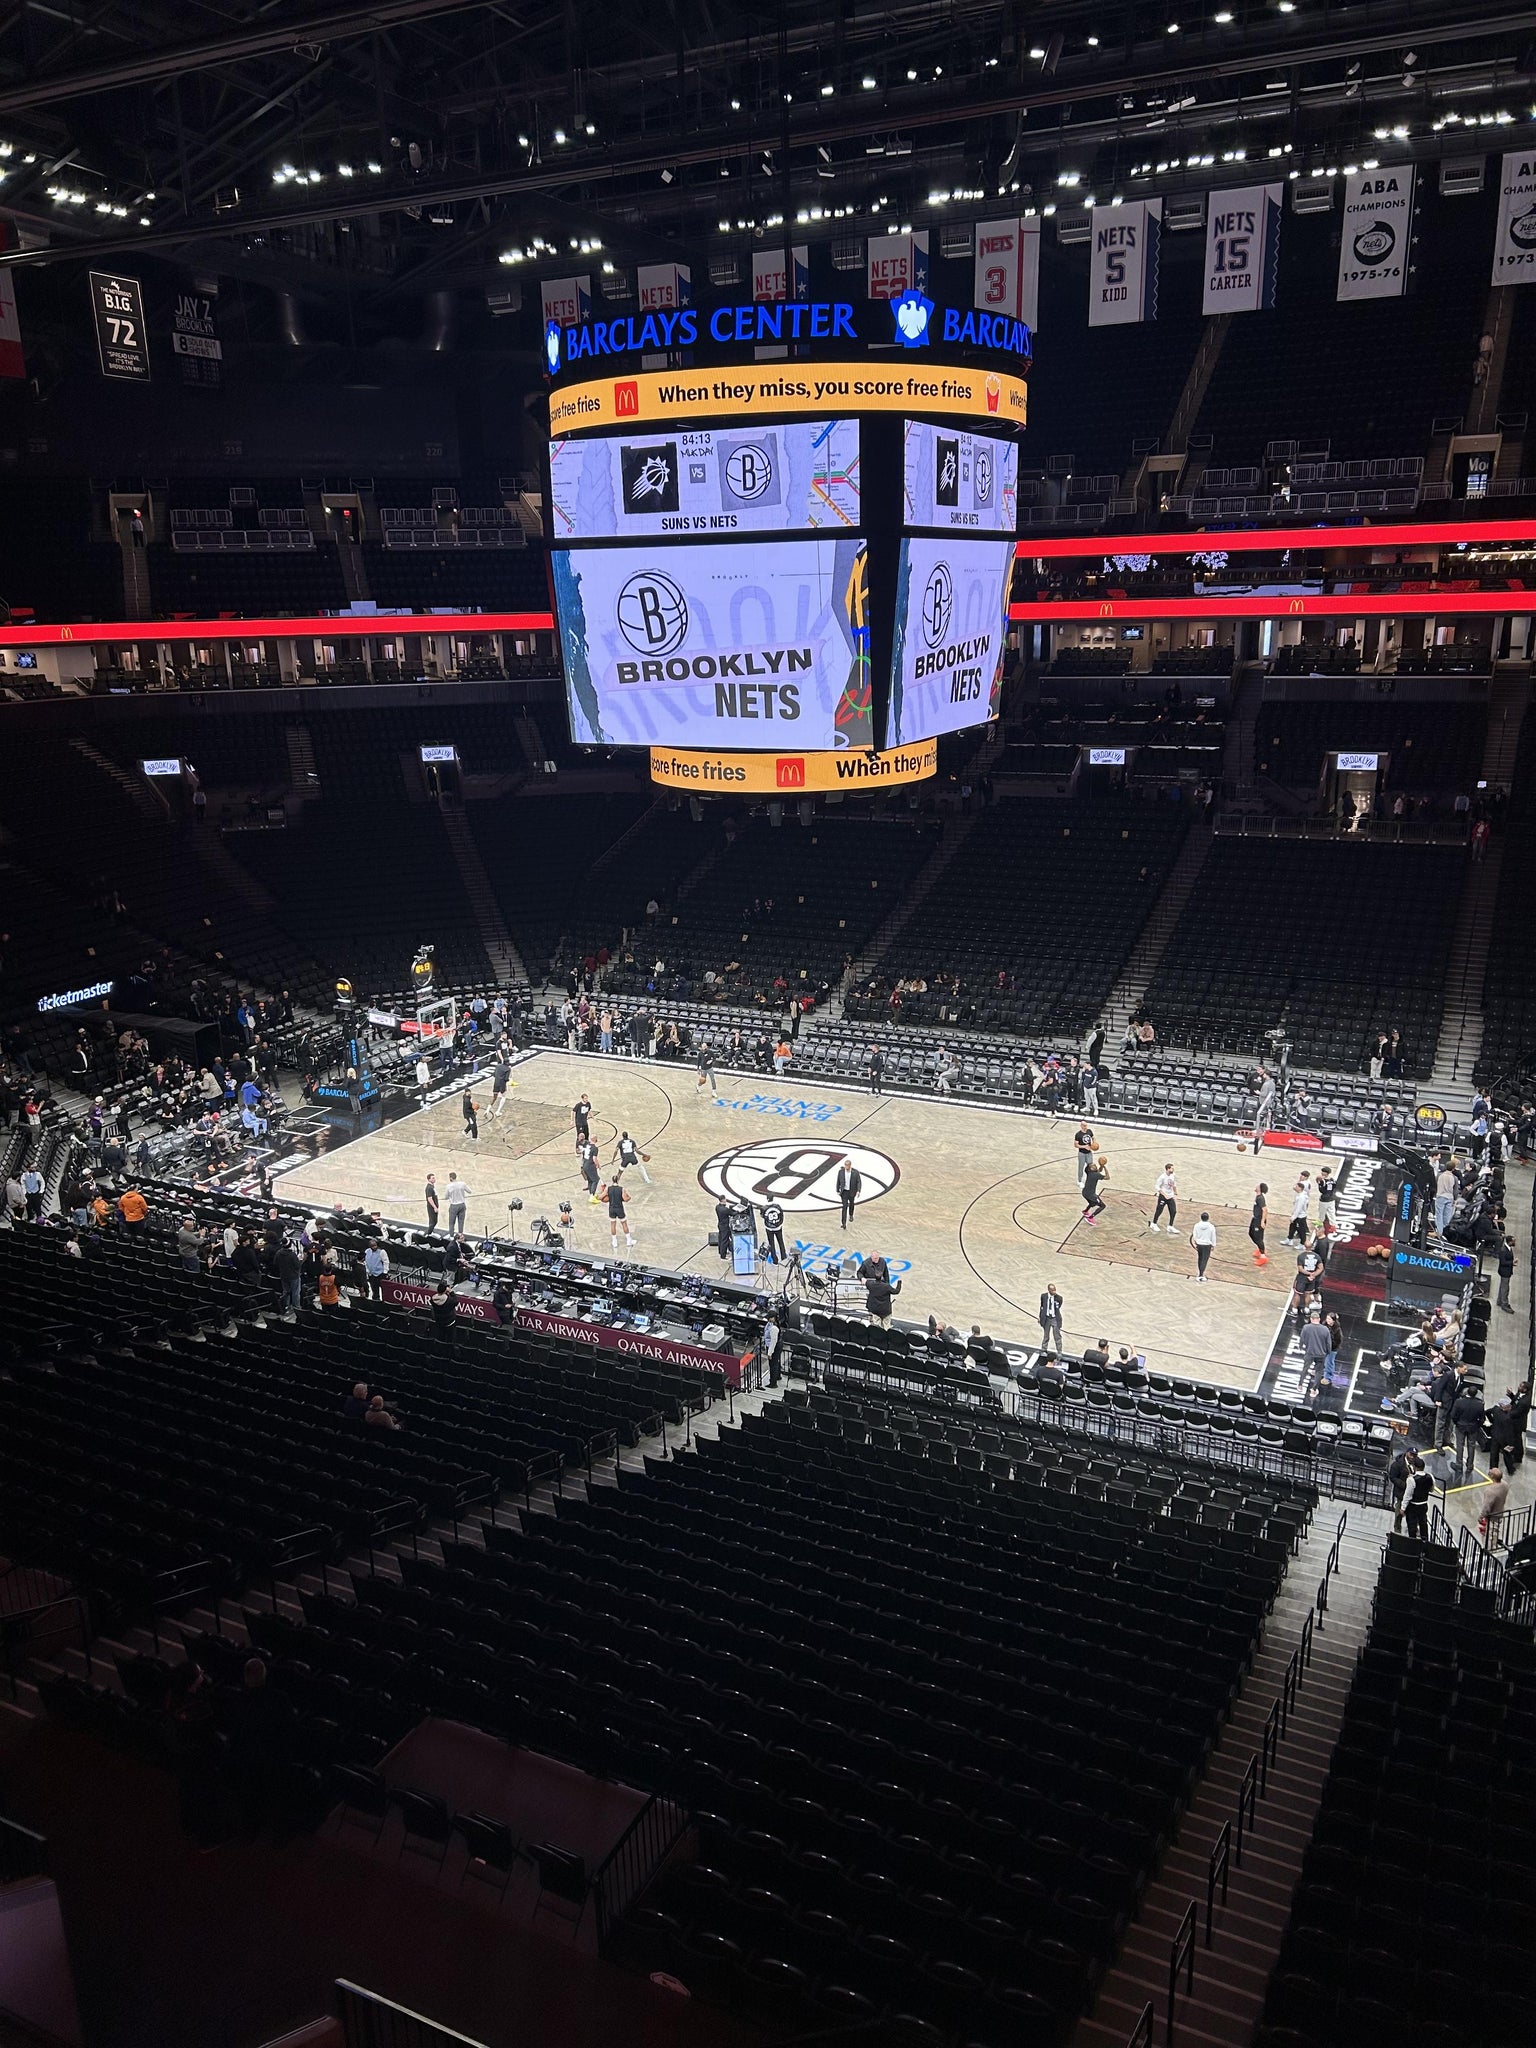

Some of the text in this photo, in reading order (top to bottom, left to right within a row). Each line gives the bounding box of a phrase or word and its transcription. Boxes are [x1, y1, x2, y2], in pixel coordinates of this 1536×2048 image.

[1360, 178, 1399, 195] ABA
[1347, 199, 1406, 213] CHAMPIONS
[1214, 211, 1256, 238] NETS
[979, 234, 1014, 258] NETS
[1097, 225, 1136, 253] NETS
[1362, 237, 1383, 249] nets
[1214, 236, 1250, 274] 15
[871, 258, 907, 279] NETS
[1105, 250, 1126, 285] 5
[1343, 267, 1400, 282] 1975-76
[985, 266, 1007, 304] 3
[1210, 273, 1252, 291] CARTER
[104, 293, 133, 312] B.I.G.
[642, 286, 673, 305] NETS
[1102, 286, 1127, 303] KIDD
[175, 295, 198, 318] JAY
[545, 300, 575, 317] NETS
[106, 317, 137, 346] 72
[176, 317, 215, 334] BROOKLYN
[567, 303, 857, 361] BARCLAYS CENTER
[943, 308, 1030, 357] BARCLAYS
[658, 378, 972, 408] When they miss, you score free fries
[561, 401, 576, 417] free
[577, 396, 600, 414] fries
[682, 433, 711, 445] 84:13
[698, 446, 714, 457] DAY
[691, 466, 704, 478] VS
[661, 515, 738, 530] SUNS VS NETS
[617, 648, 812, 684] BROOKLYN
[914, 635, 990, 679] BROOKLYN
[950, 667, 982, 703] NETS
[714, 682, 801, 720] NETS
[148, 761, 177, 773] BROOKLYN
[836, 760, 890, 779] When
[894, 755, 924, 777] they
[1093, 751, 1122, 762] BROOKLYN
[1341, 756, 1374, 767] BROOKLYN
[671, 758, 700, 778] free
[702, 761, 746, 781] fries
[38, 981, 113, 1012] ticketmaster
[713, 1098, 833, 1121] BARCLAYS
[750, 1094, 843, 1113] CENTER
[1335, 1158, 1382, 1210] Brooklyn
[1402, 1191, 1411, 1220] BARCLAYS
[1327, 1210, 1367, 1243] Nets
[1409, 1255, 1463, 1273] BARCLAYS
[393, 1289, 431, 1306] QATAR
[513, 1315, 600, 1344] ATAR AIRWAYS
[618, 1338, 725, 1374] QATAR AIRWAYS
